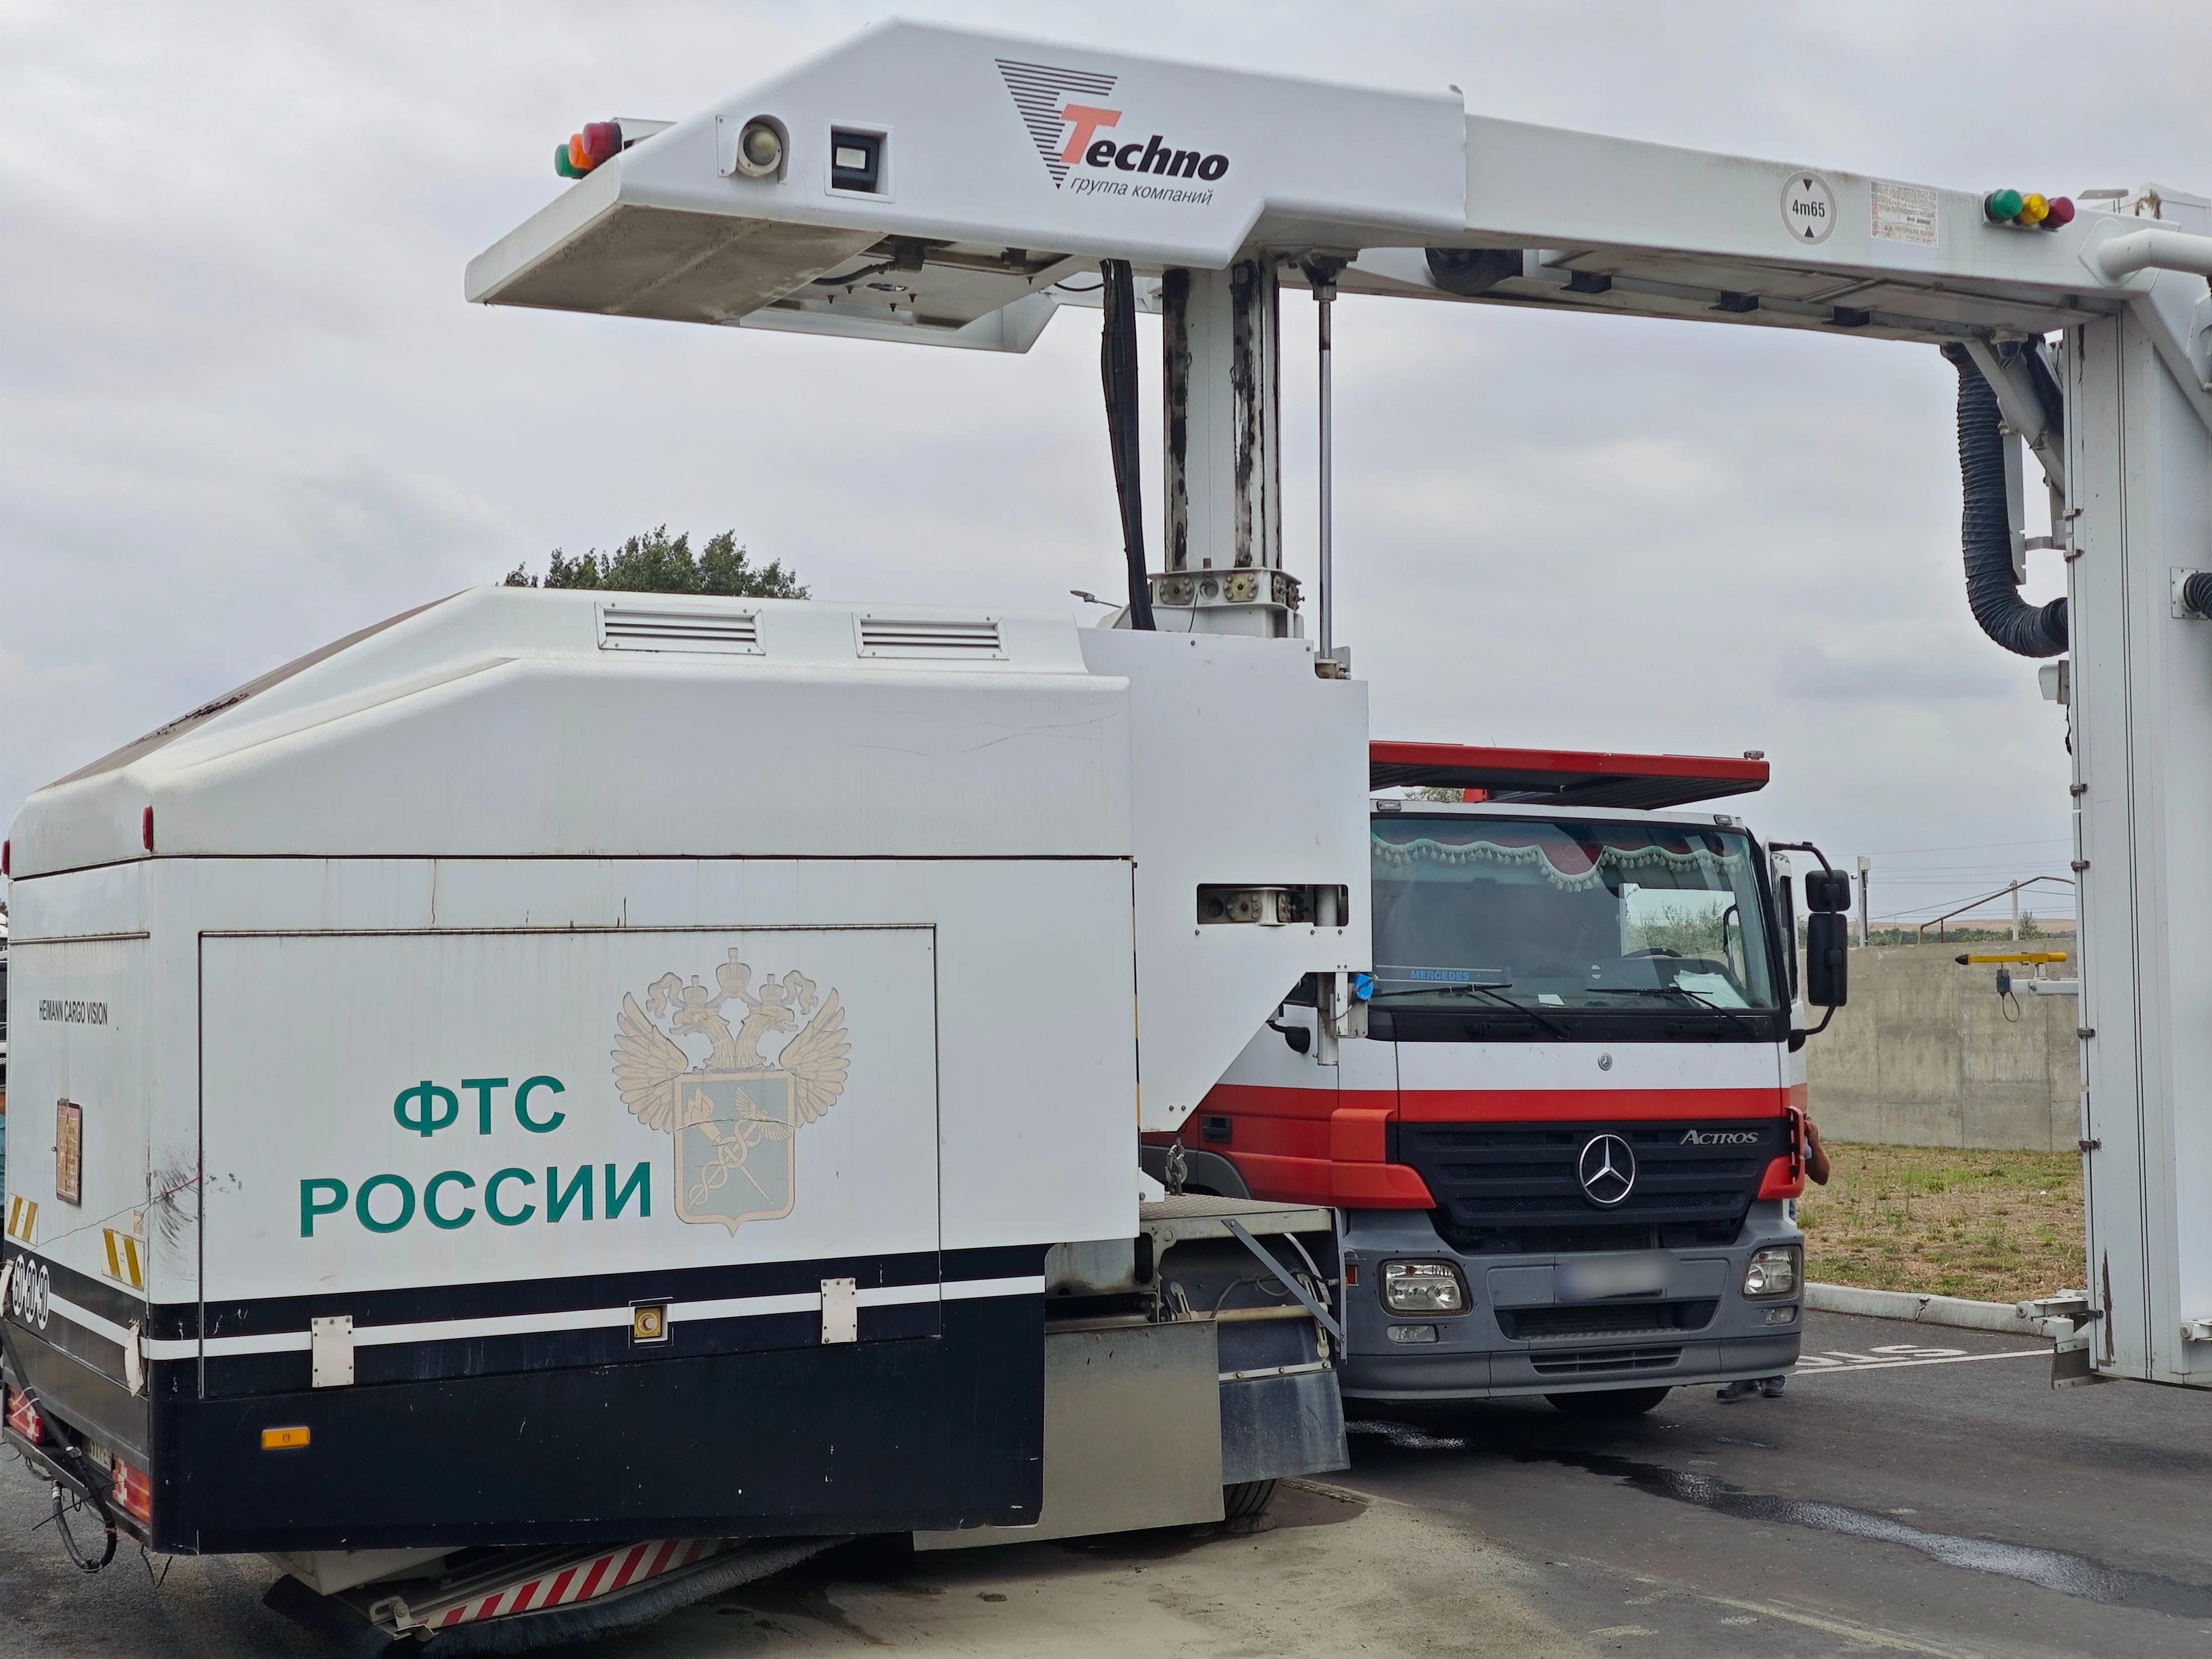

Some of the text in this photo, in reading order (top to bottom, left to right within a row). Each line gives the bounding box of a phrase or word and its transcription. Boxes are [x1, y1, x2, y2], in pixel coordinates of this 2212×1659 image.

[1060, 103, 1229, 181] Techno
[1070, 176, 1215, 206] группа компаний
[1792, 199, 1825, 218] 4m65
[1410, 970, 1471, 982] MERCEDES
[39, 1000, 107, 1026] HEIMANN CARGO VISION
[394, 1075, 566, 1137] ФТС
[300, 1162, 651, 1237] РОССИИ
[15, 1260, 24, 1309] 60
[26, 1266, 36, 1316] 80
[38, 1271, 48, 1323] 90
